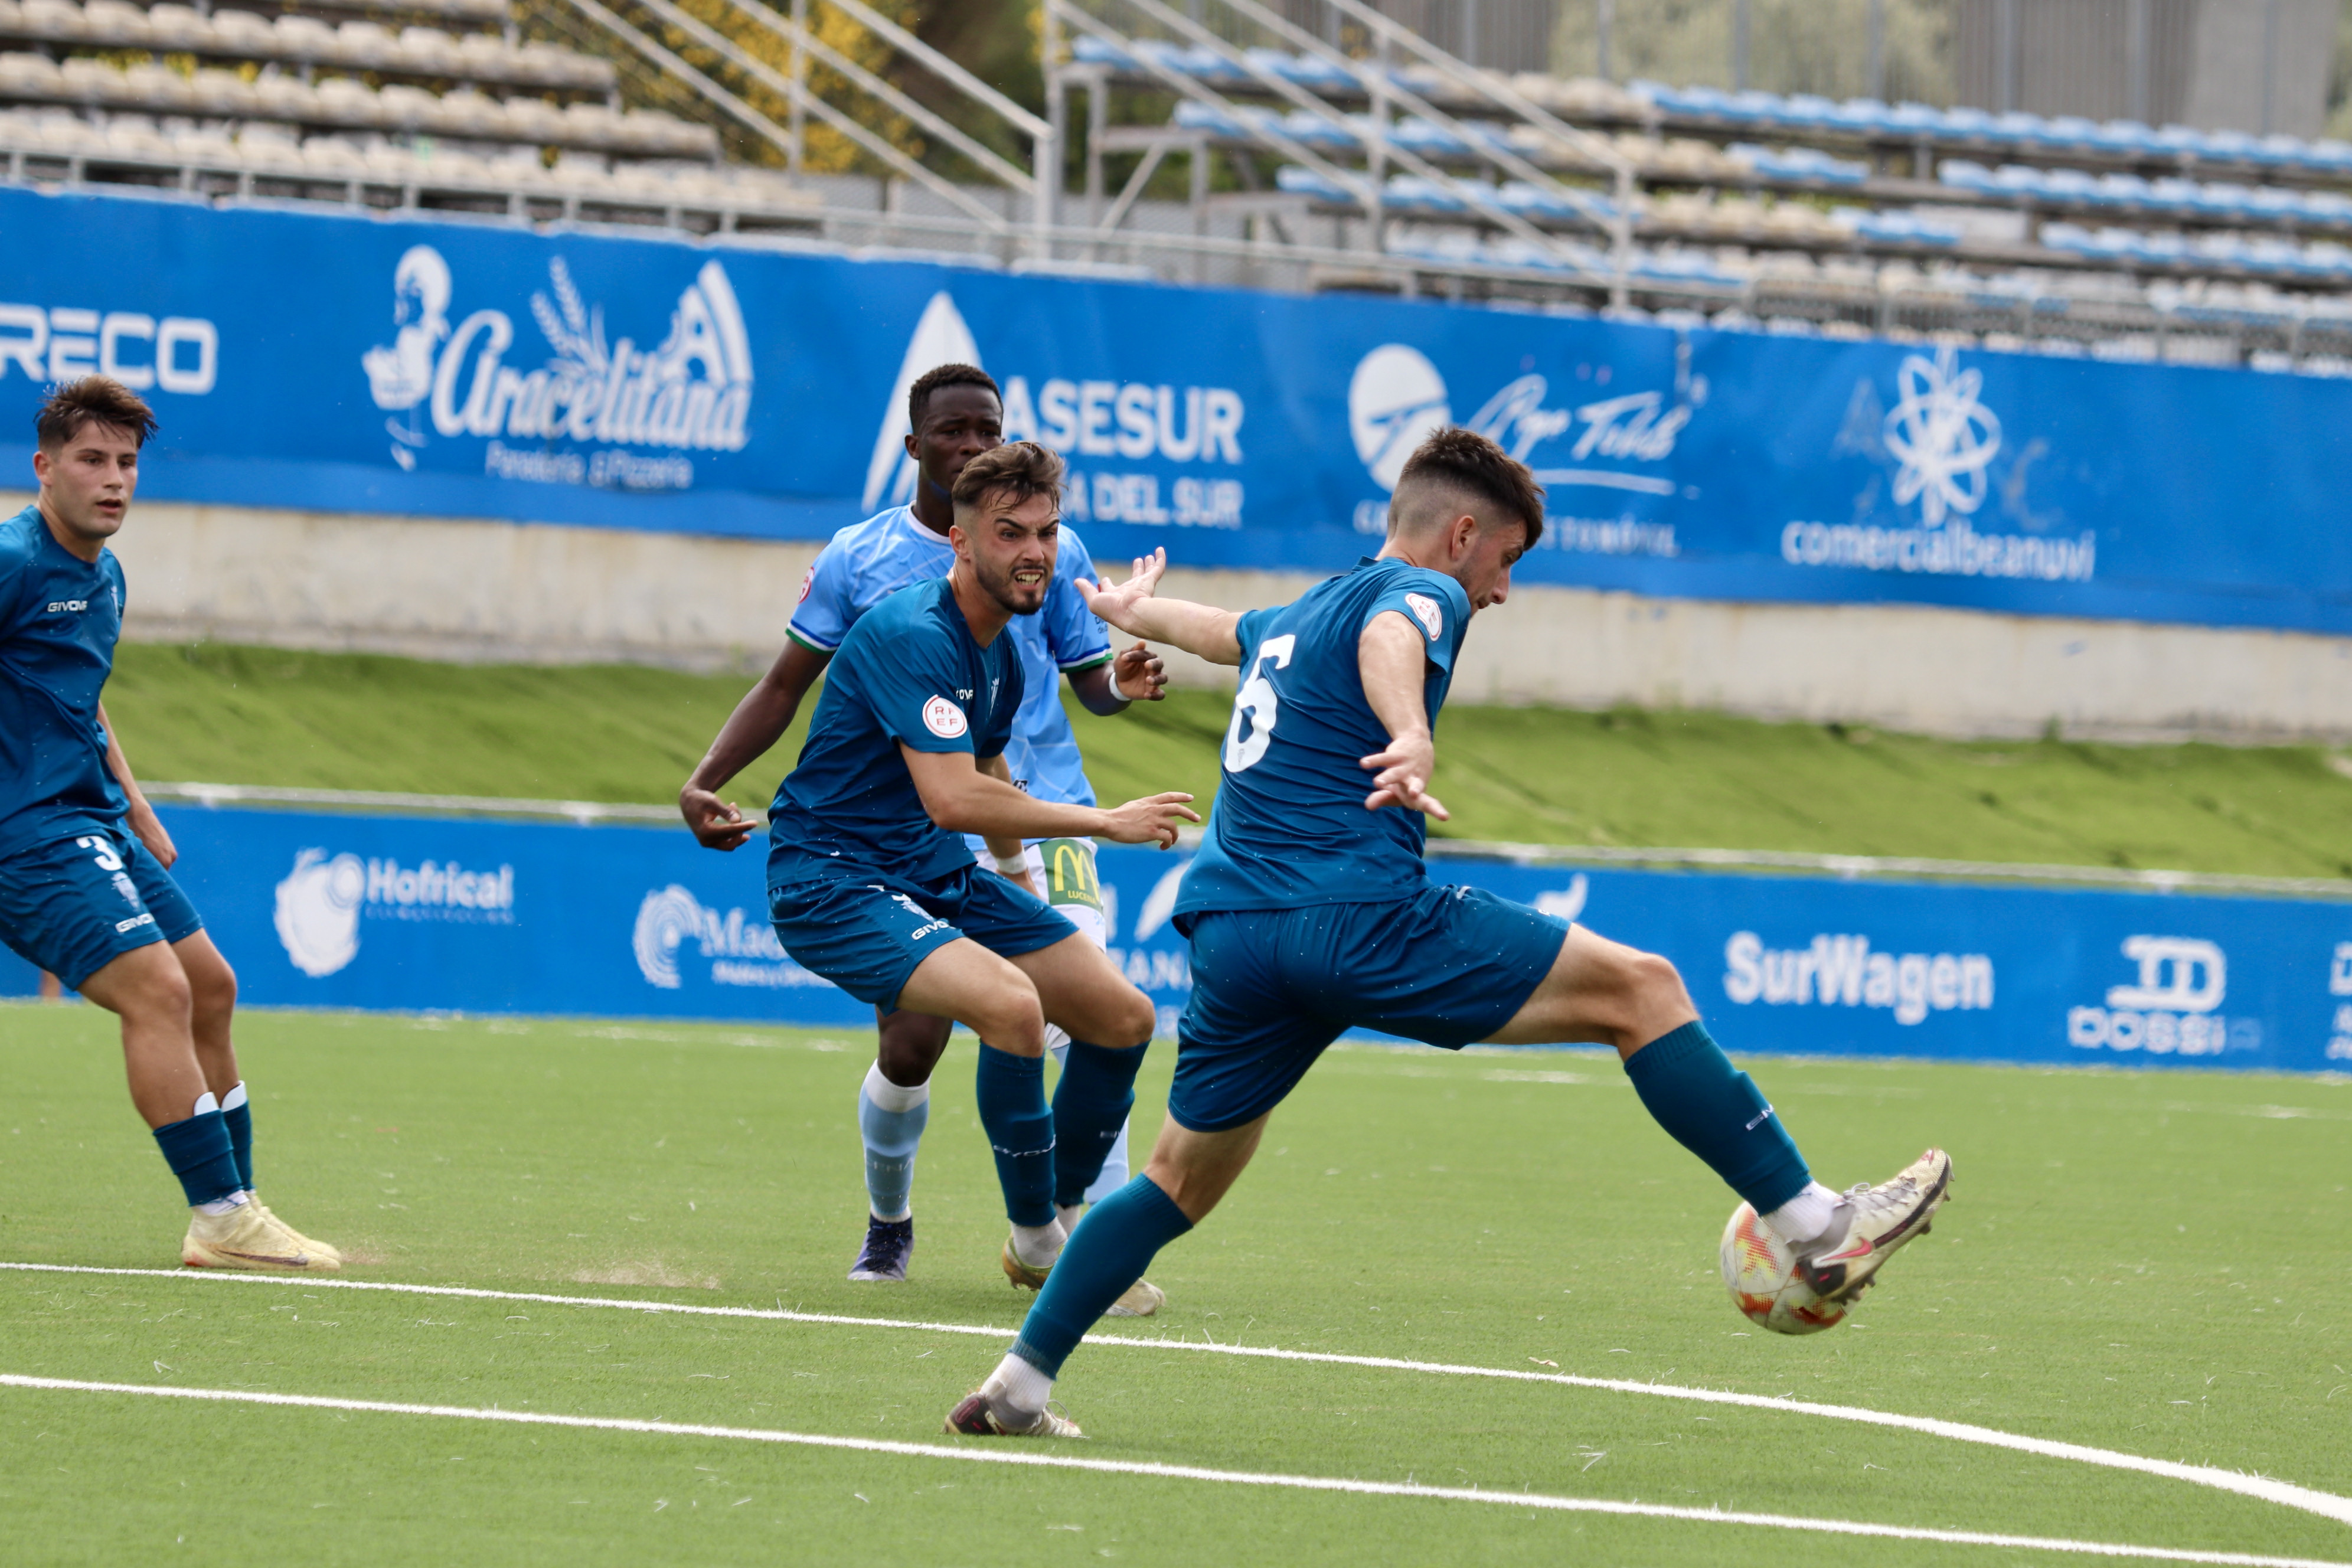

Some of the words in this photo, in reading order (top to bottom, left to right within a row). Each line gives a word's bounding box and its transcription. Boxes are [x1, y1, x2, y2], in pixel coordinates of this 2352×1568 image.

[1002, 375, 1244, 465] ASESUR
[1092, 472, 1168, 527] DEL
[1171, 476, 1244, 531] SUR
[1224, 634, 1295, 773] 6
[76, 835, 123, 871] 3
[367, 857, 515, 910] Hofrical
[1723, 930, 1994, 1026] SurWagen
